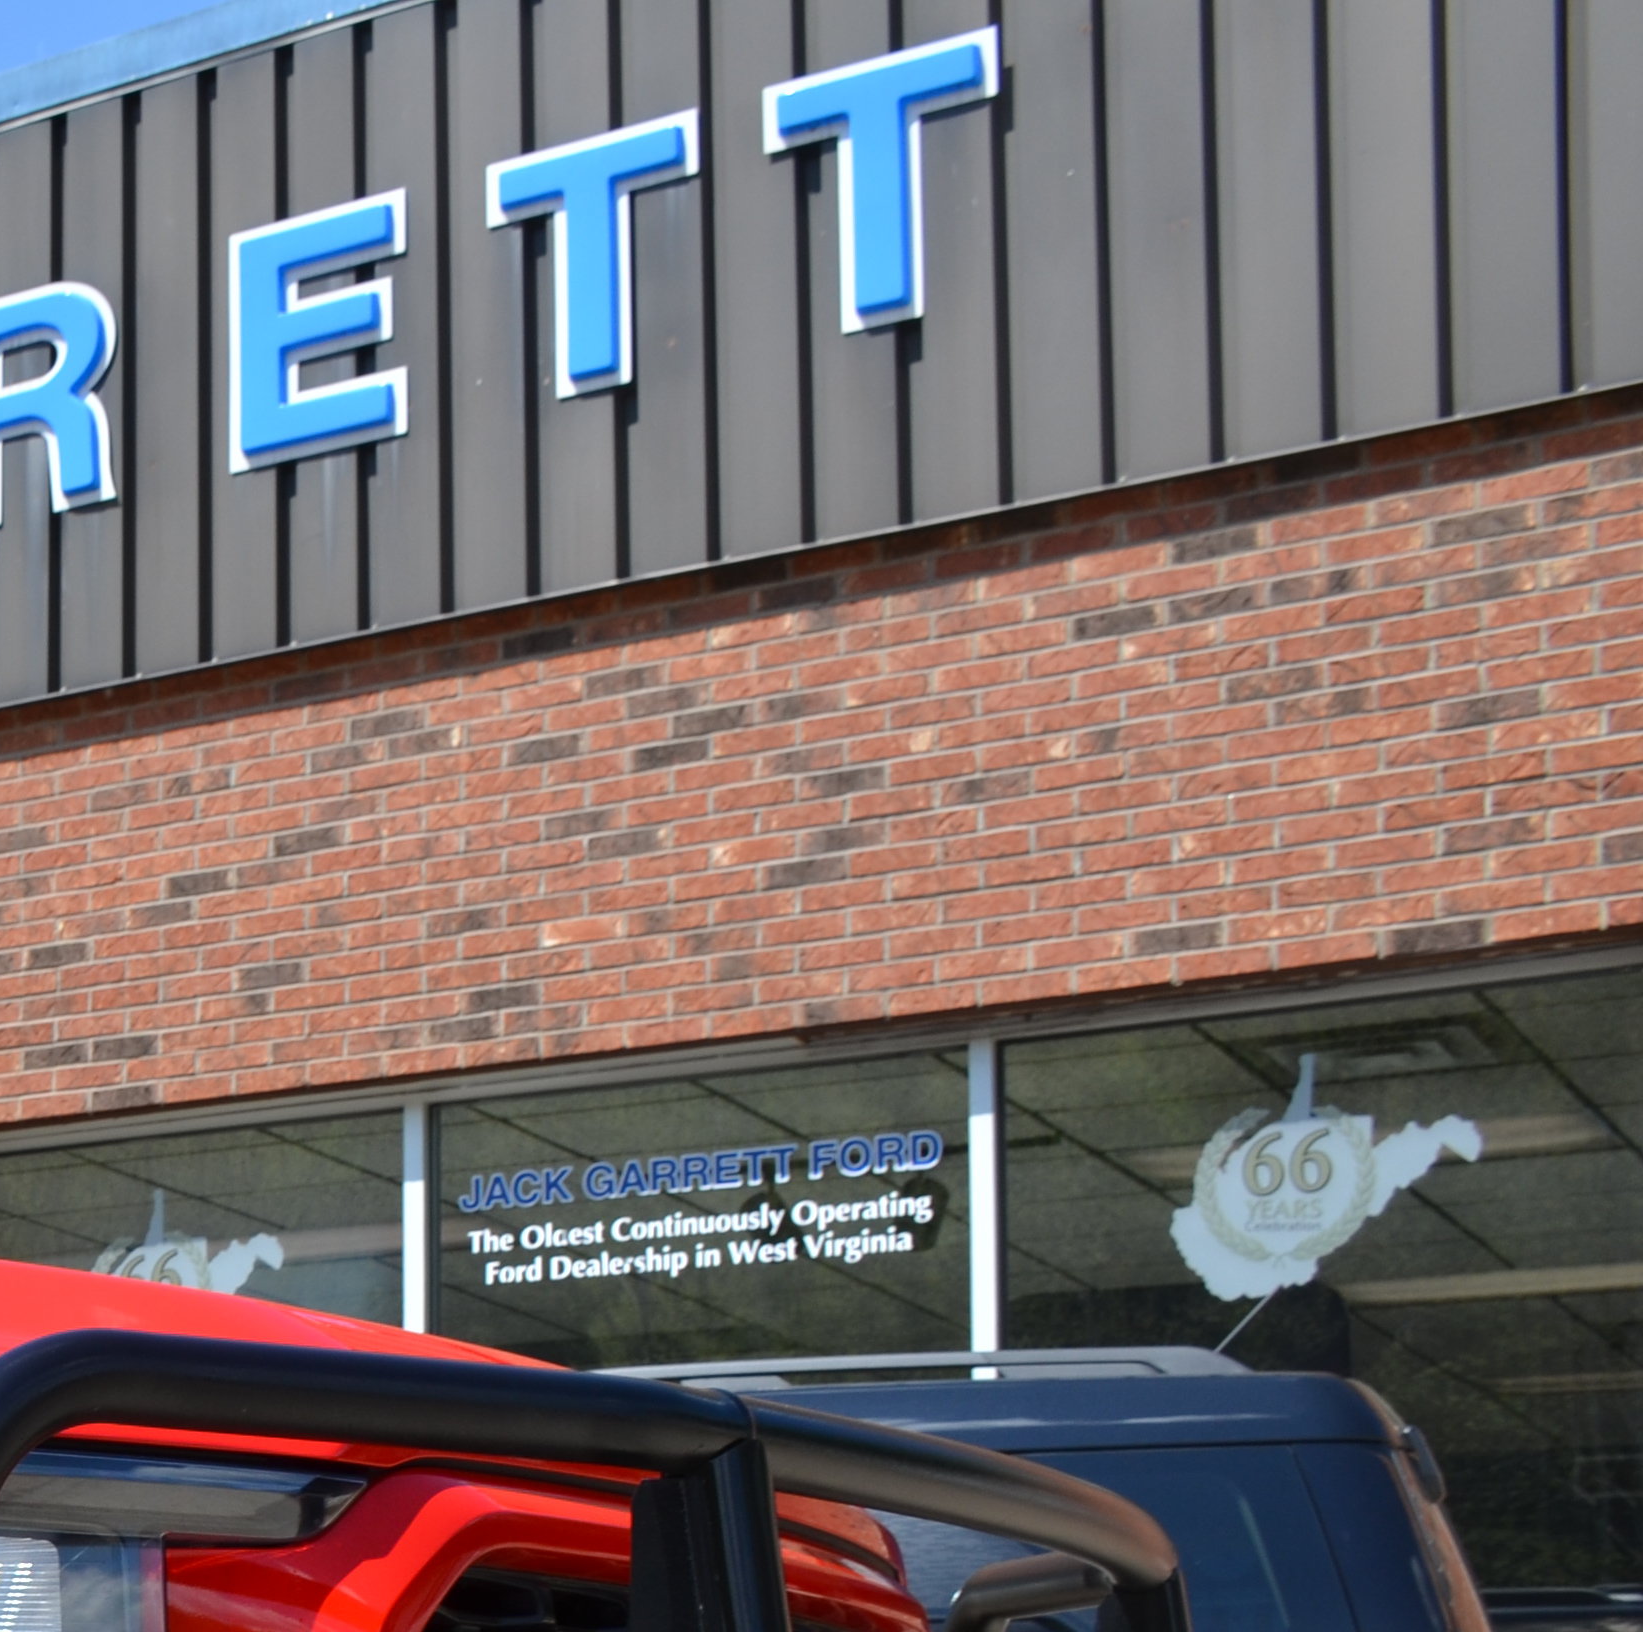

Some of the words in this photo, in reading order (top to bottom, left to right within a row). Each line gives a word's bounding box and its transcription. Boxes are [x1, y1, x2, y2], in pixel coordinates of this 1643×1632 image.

[459, 1166, 574, 1213] JACK
[582, 1143, 799, 1200] GARRETT
[807, 1130, 944, 1181] FORD
[1241, 1128, 1333, 1197] 66
[467, 1228, 515, 1254] The
[520, 1220, 604, 1249] Oldest
[610, 1202, 785, 1242] Continuously
[791, 1191, 934, 1231] Operating
[1246, 1198, 1323, 1220] YEARS
[484, 1256, 543, 1286] Ford
[549, 1244, 689, 1278] Dealership
[695, 1242, 721, 1268] in
[727, 1237, 798, 1266] West
[802, 1225, 914, 1264] Virginia
